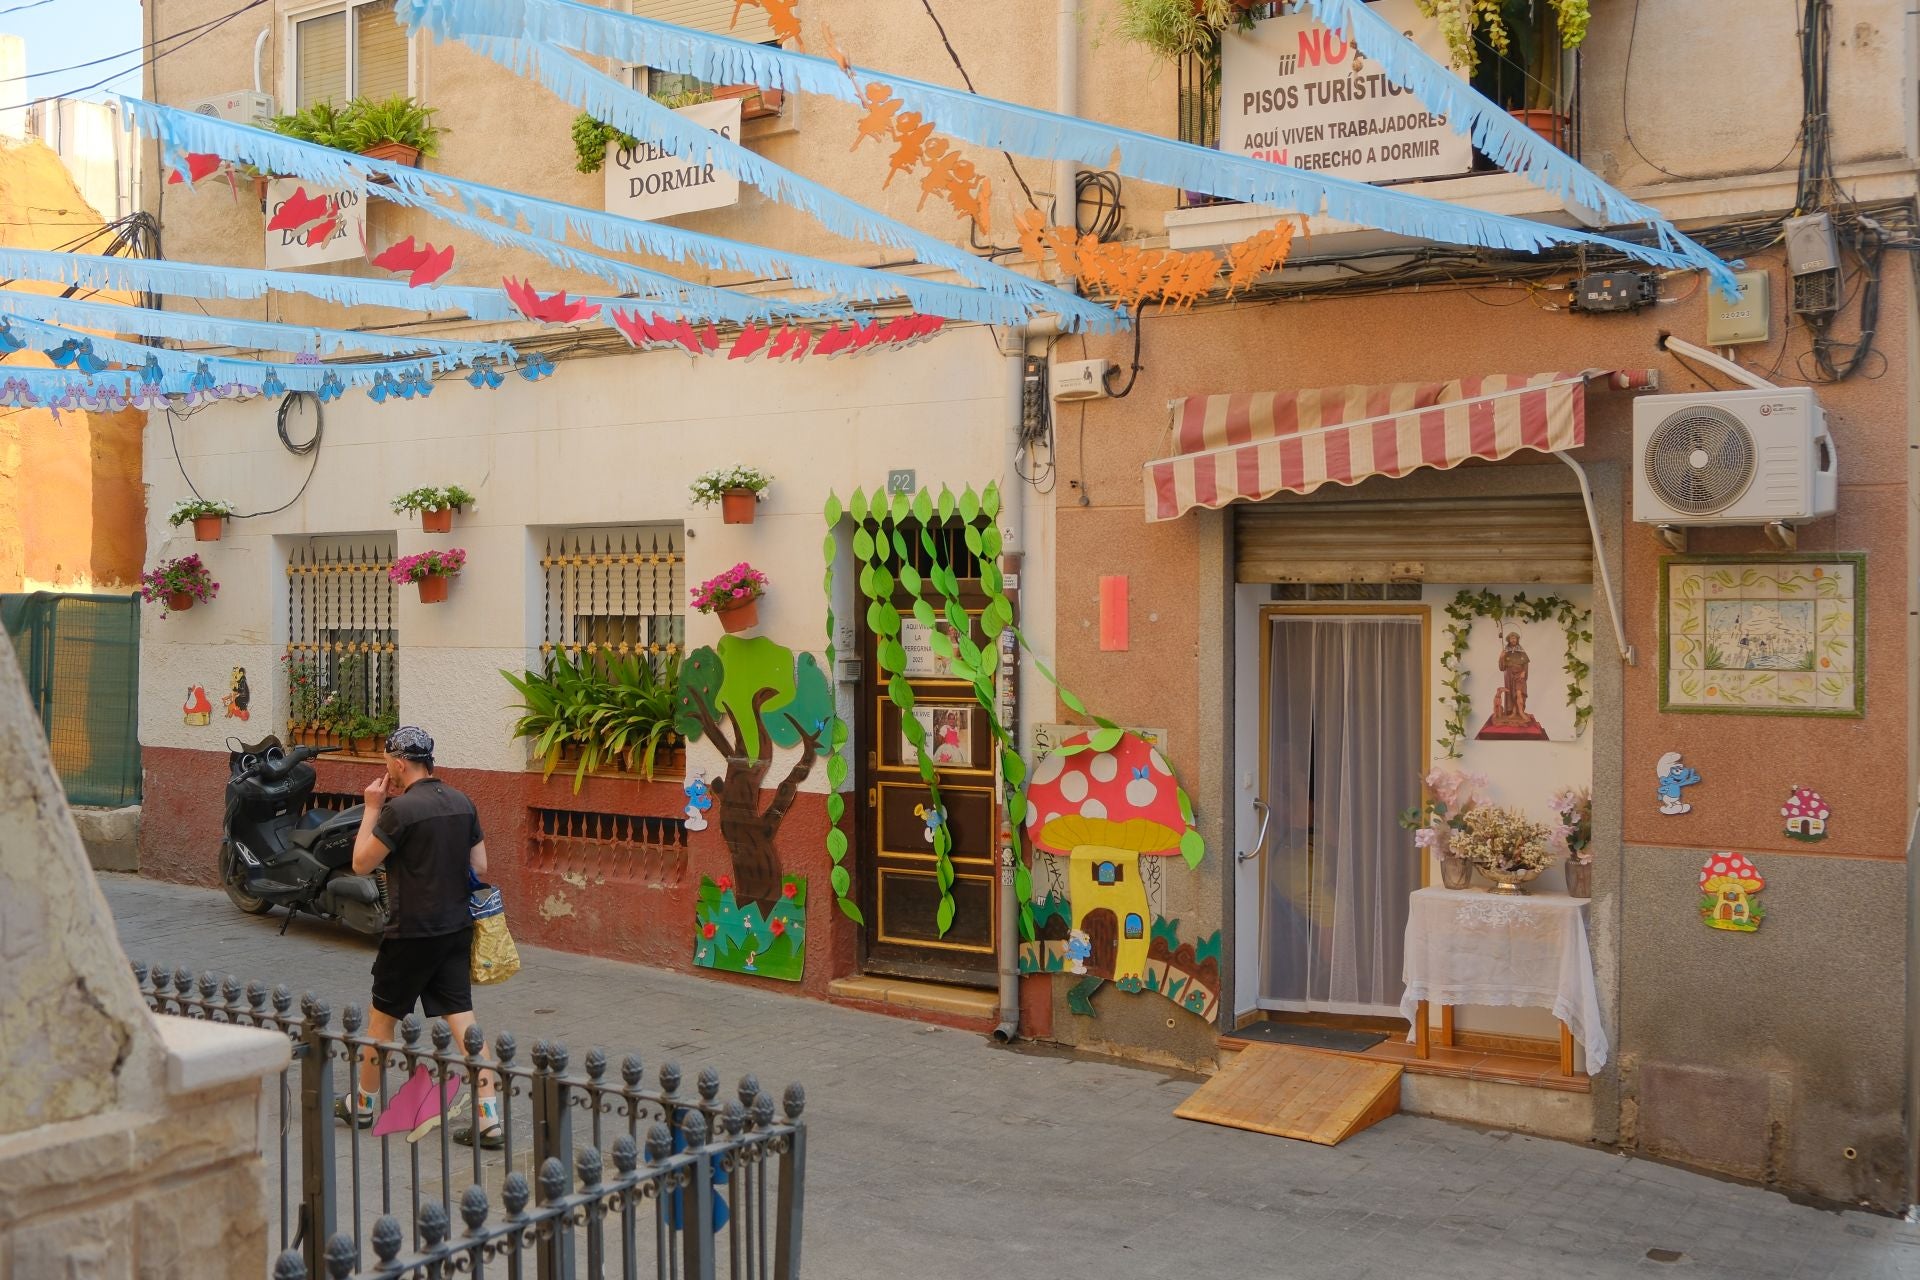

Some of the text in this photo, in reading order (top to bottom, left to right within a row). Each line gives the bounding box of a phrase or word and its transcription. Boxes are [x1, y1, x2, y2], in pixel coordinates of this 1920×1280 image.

[1243, 72, 1415, 116] PISOS TURÍSTIC
[1244, 112, 1447, 150] AQUÍ VIVEN TRABAJADORES
[1294, 148, 1361, 171] DERECHO
[1366, 148, 1377, 164] A
[1380, 139, 1440, 161] DORMIR
[629, 163, 716, 199] DORMIR
[893, 474, 911, 491] 22
